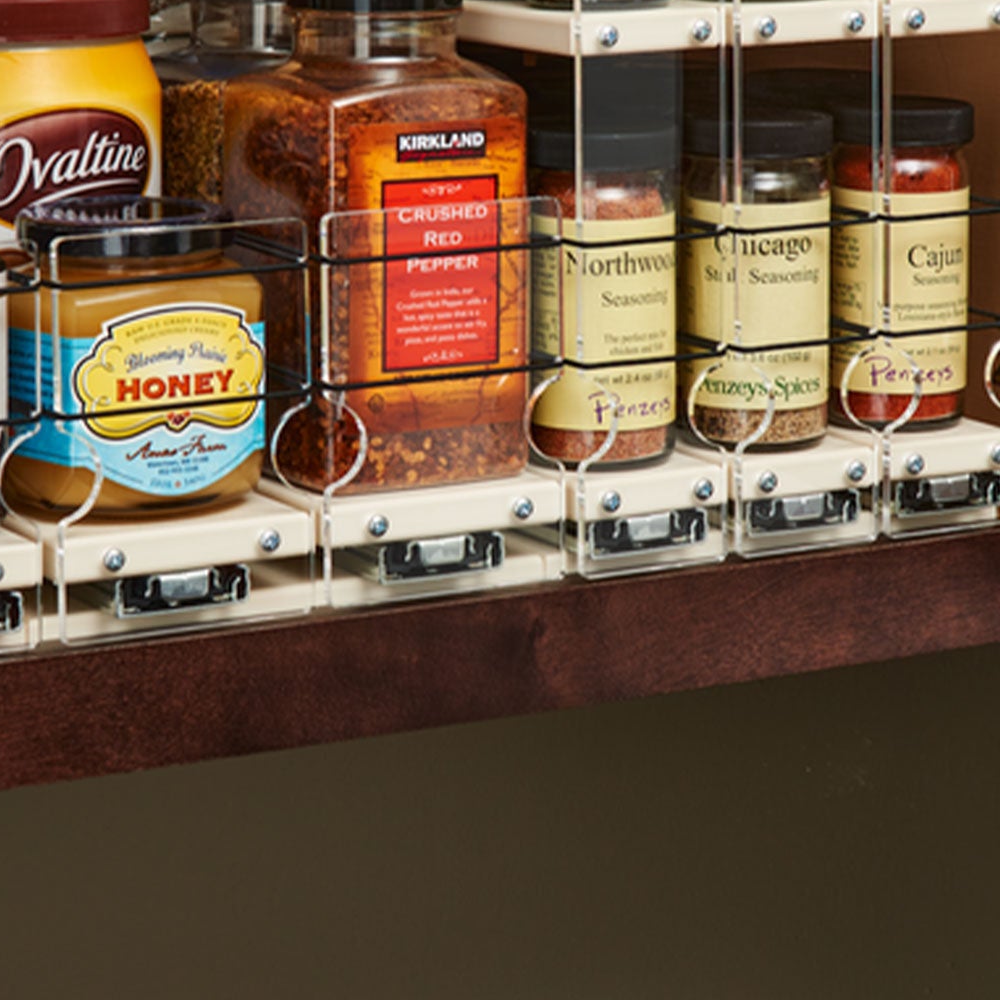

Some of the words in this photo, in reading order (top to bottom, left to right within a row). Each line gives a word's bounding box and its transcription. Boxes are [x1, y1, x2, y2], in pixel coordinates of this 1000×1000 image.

[399, 131, 485, 152] KIRKLAND
[397, 203, 488, 225] CRUSHED
[424, 229, 464, 247] RED
[406, 253, 479, 274] PEPPER
[749, 265, 820, 285] Seasoning
[601, 289, 668, 309] Seasoning
[124, 348, 186, 373] Blooming
[116, 368, 234, 403] HONEY
[699, 376, 768, 403] enzeys
[774, 375, 821, 402] Spices
